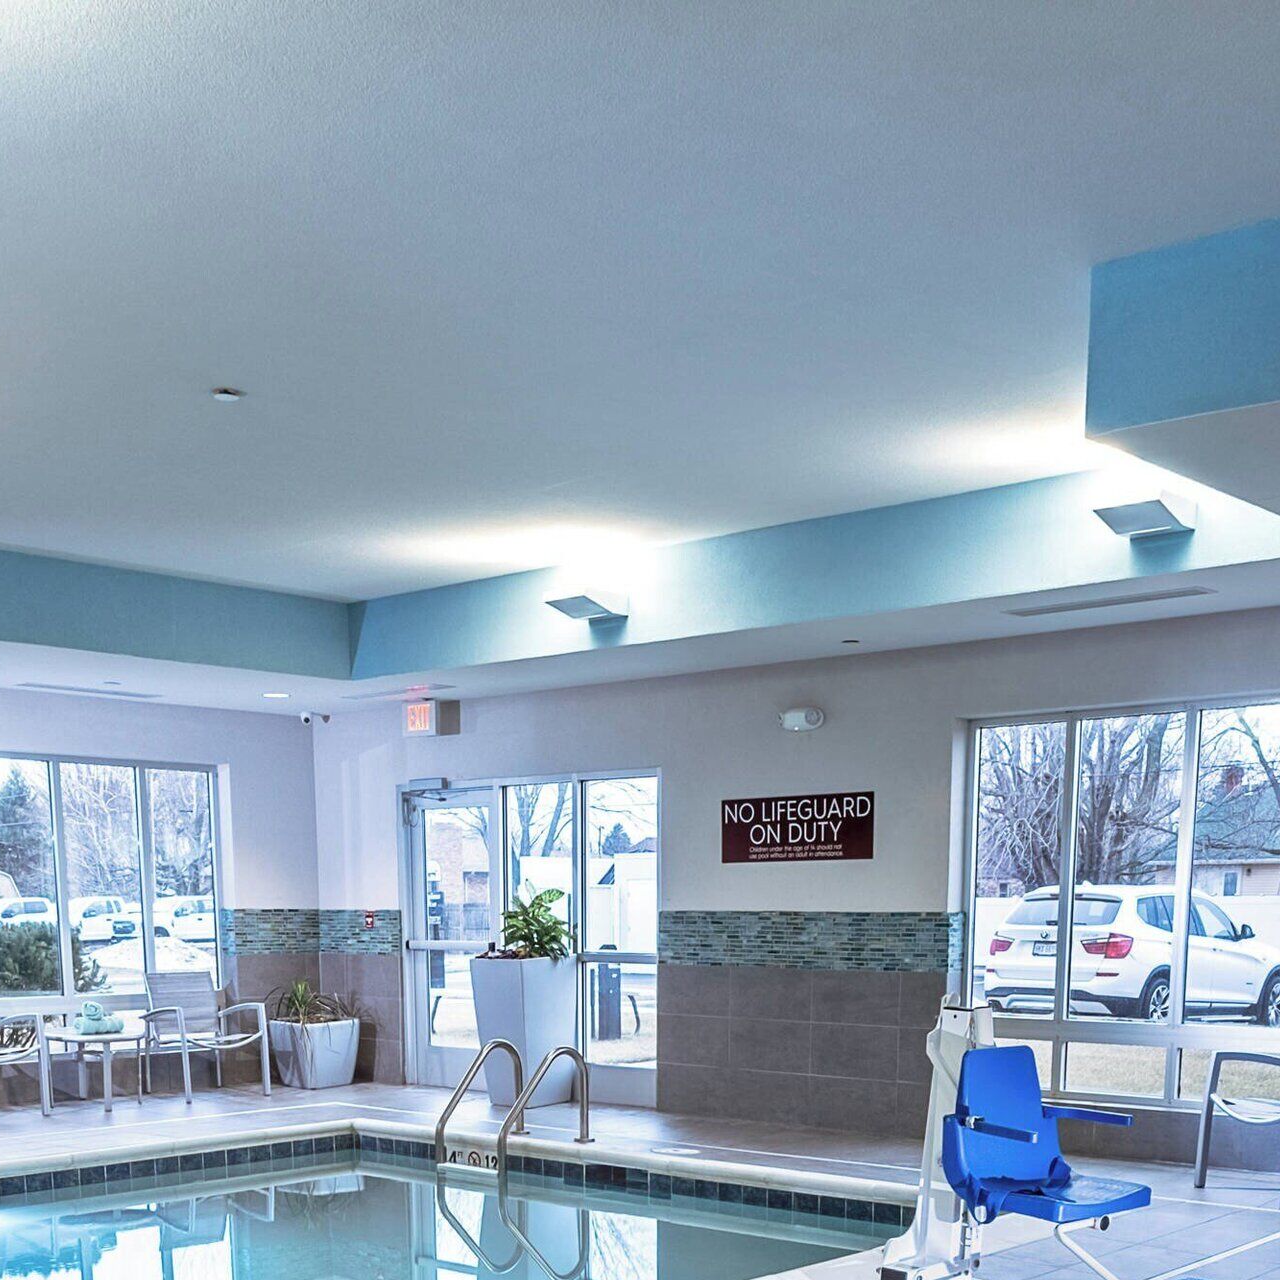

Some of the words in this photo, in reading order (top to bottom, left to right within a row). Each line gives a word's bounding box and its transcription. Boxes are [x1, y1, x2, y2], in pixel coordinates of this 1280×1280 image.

[408, 704, 430, 731] EXIT
[725, 803, 755, 824] NO
[762, 796, 871, 822] LIFEGUARD
[750, 825, 780, 845] ON
[789, 821, 842, 844] DUTY
